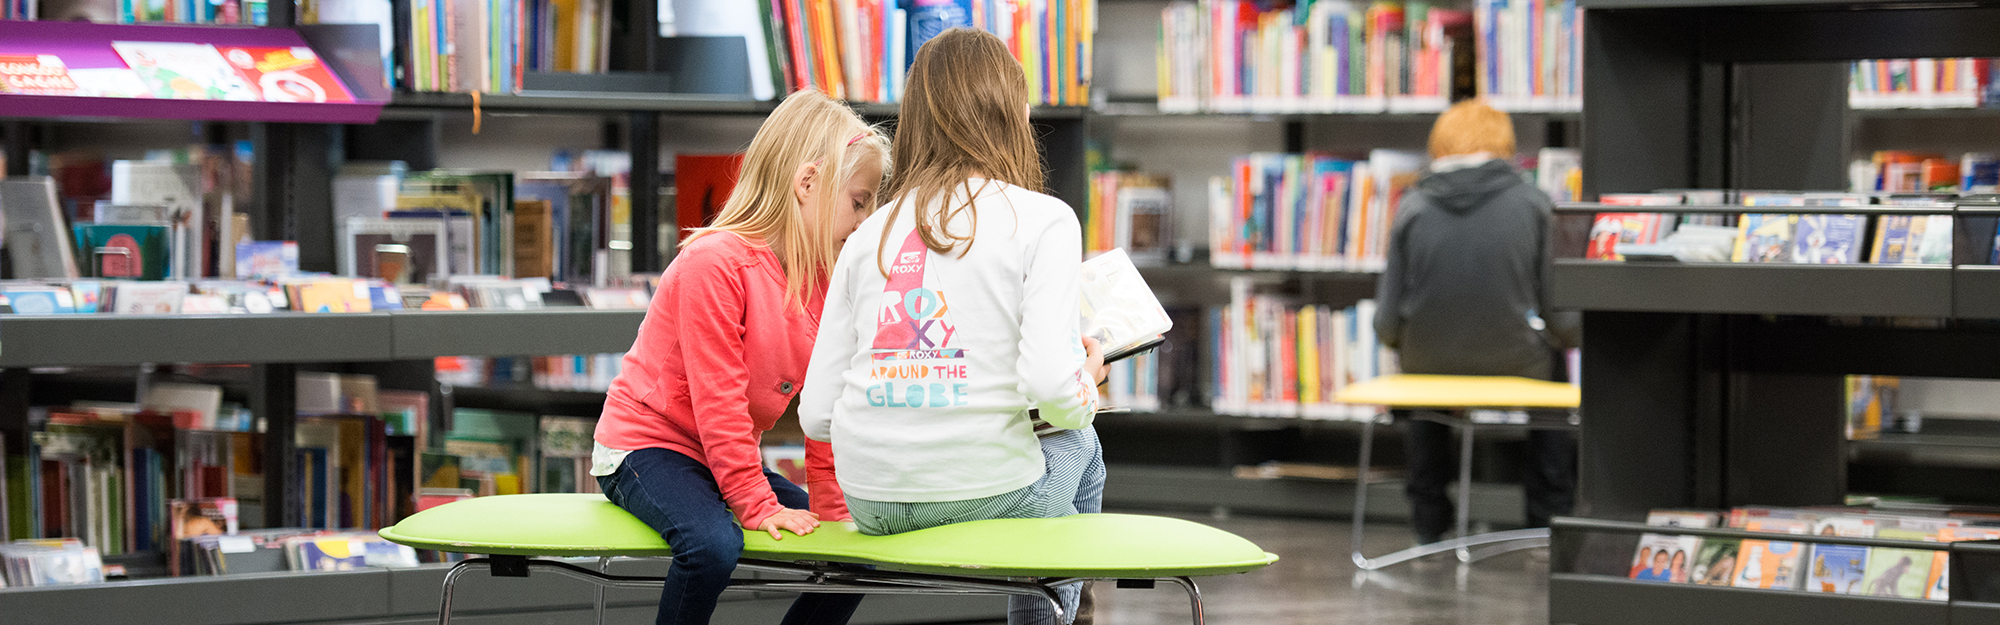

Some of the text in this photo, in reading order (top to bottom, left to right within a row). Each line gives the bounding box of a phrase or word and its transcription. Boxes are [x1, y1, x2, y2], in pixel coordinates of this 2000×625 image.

[892, 264, 923, 274] ROXY
[910, 350, 938, 359] ROXY
[870, 364, 967, 379] AROUND THE
[866, 382, 969, 408] GLOBE
